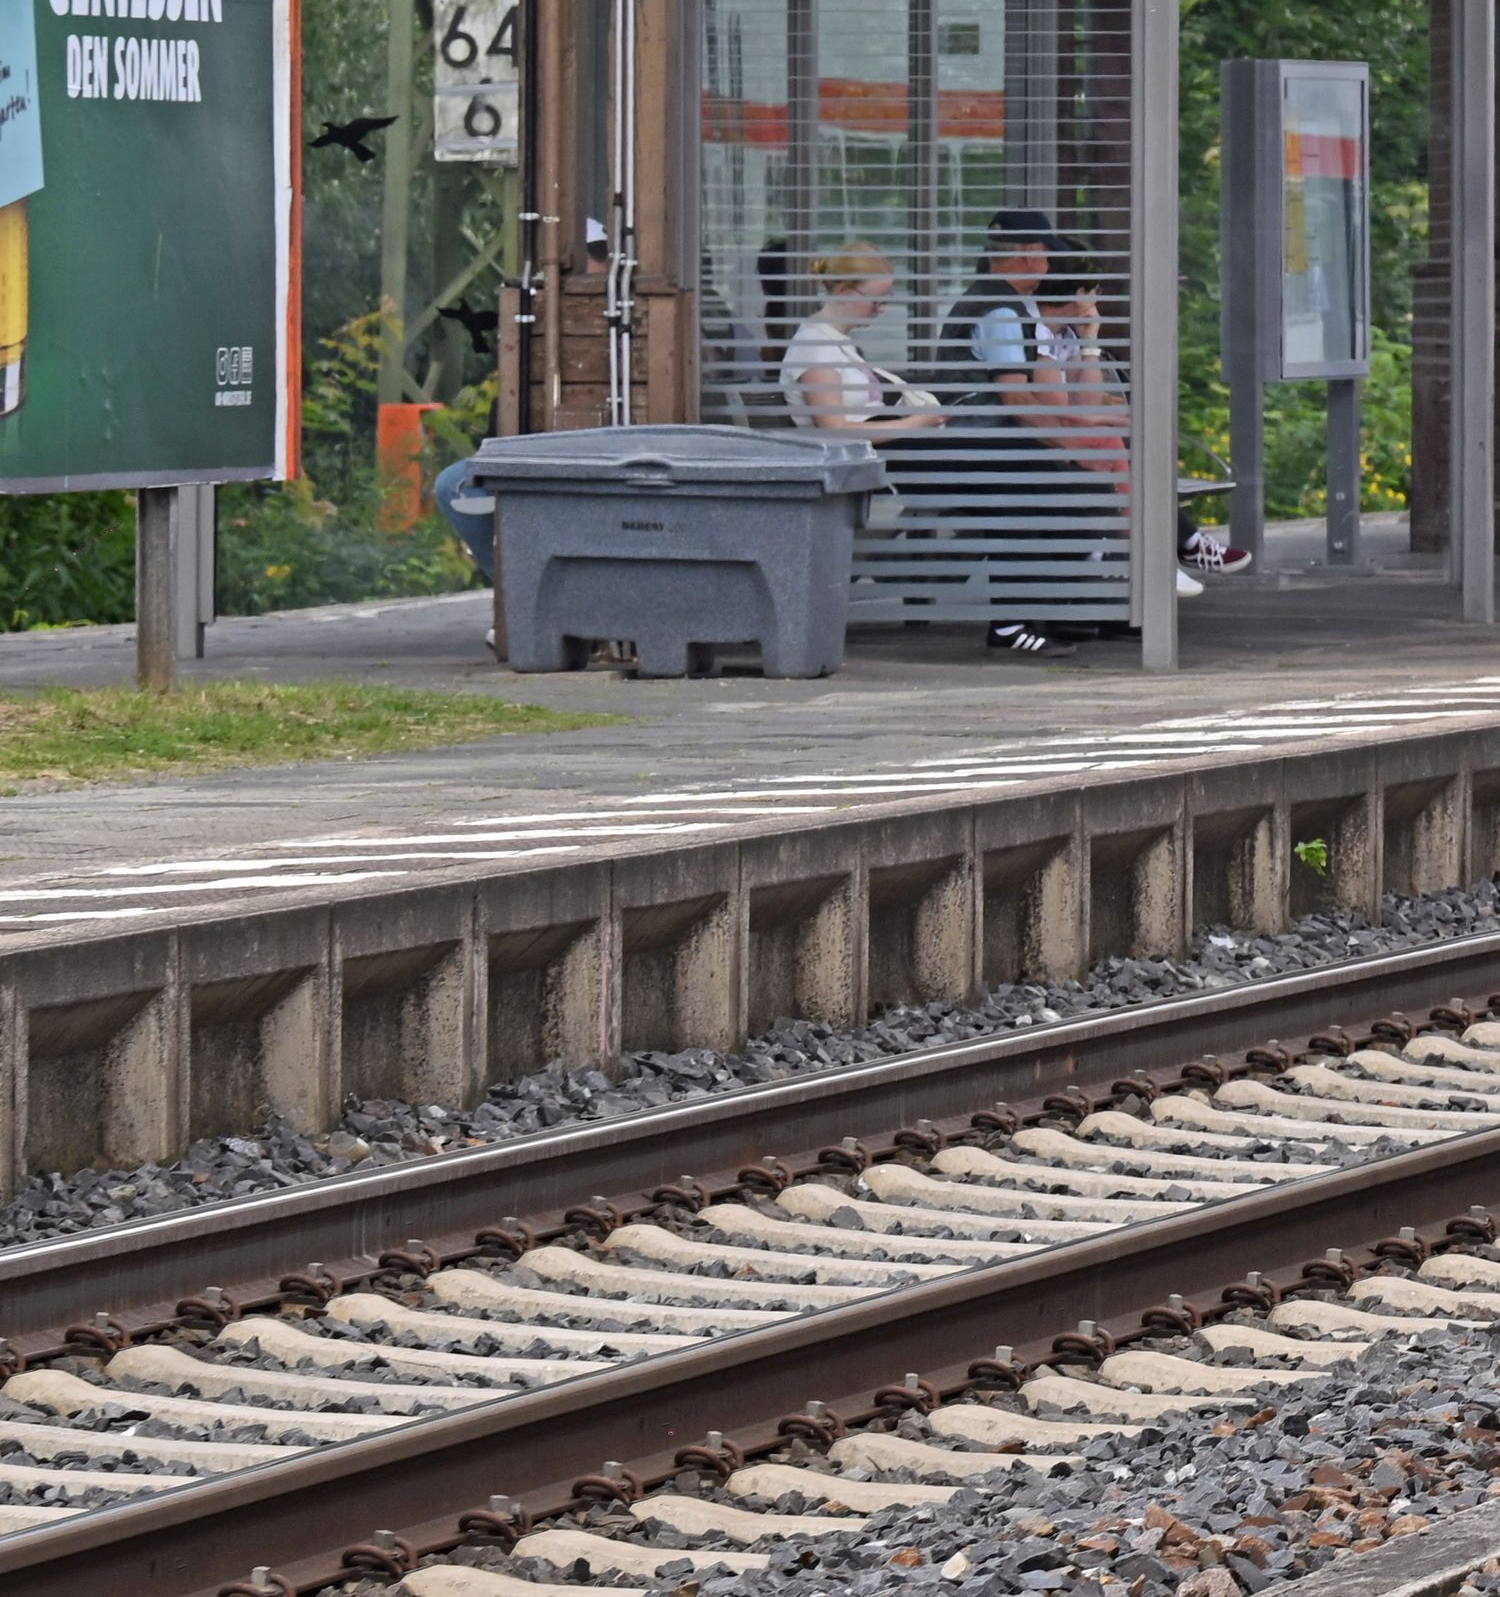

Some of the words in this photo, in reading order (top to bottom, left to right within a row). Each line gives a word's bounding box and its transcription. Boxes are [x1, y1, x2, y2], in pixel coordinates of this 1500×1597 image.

[67, 35, 108, 99] DEN
[114, 36, 201, 103] SOMMER
[440, 6, 520, 69] 64
